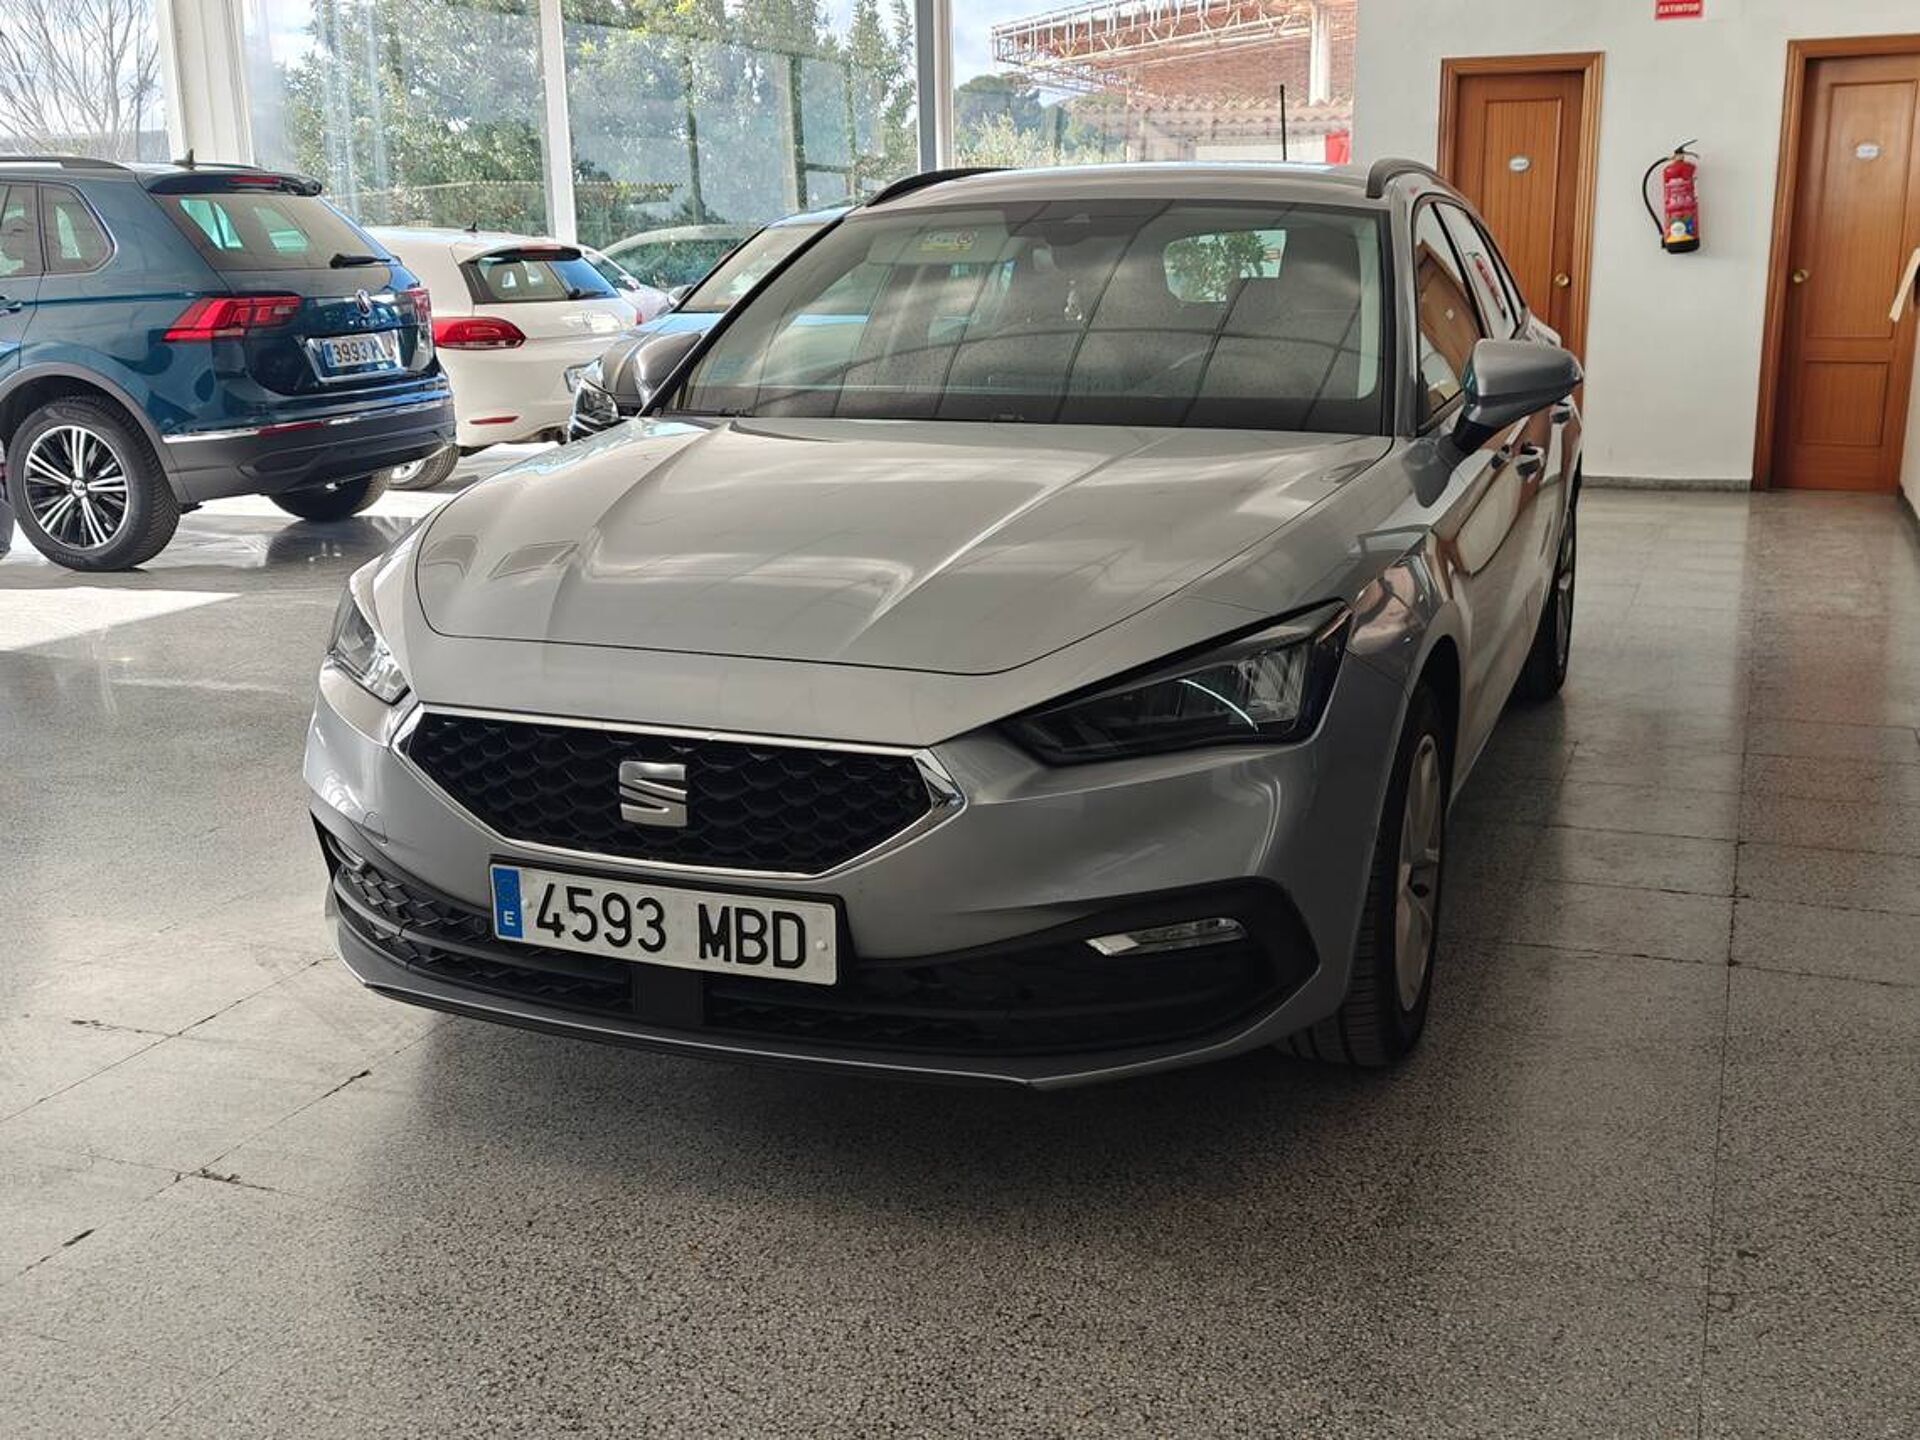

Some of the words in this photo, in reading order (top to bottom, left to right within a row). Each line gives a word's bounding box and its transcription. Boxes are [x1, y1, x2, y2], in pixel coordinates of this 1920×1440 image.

[333, 341, 368, 363] 3993
[504, 910, 515, 926] E
[536, 883, 667, 953] 4593
[698, 903, 807, 970] MBD
